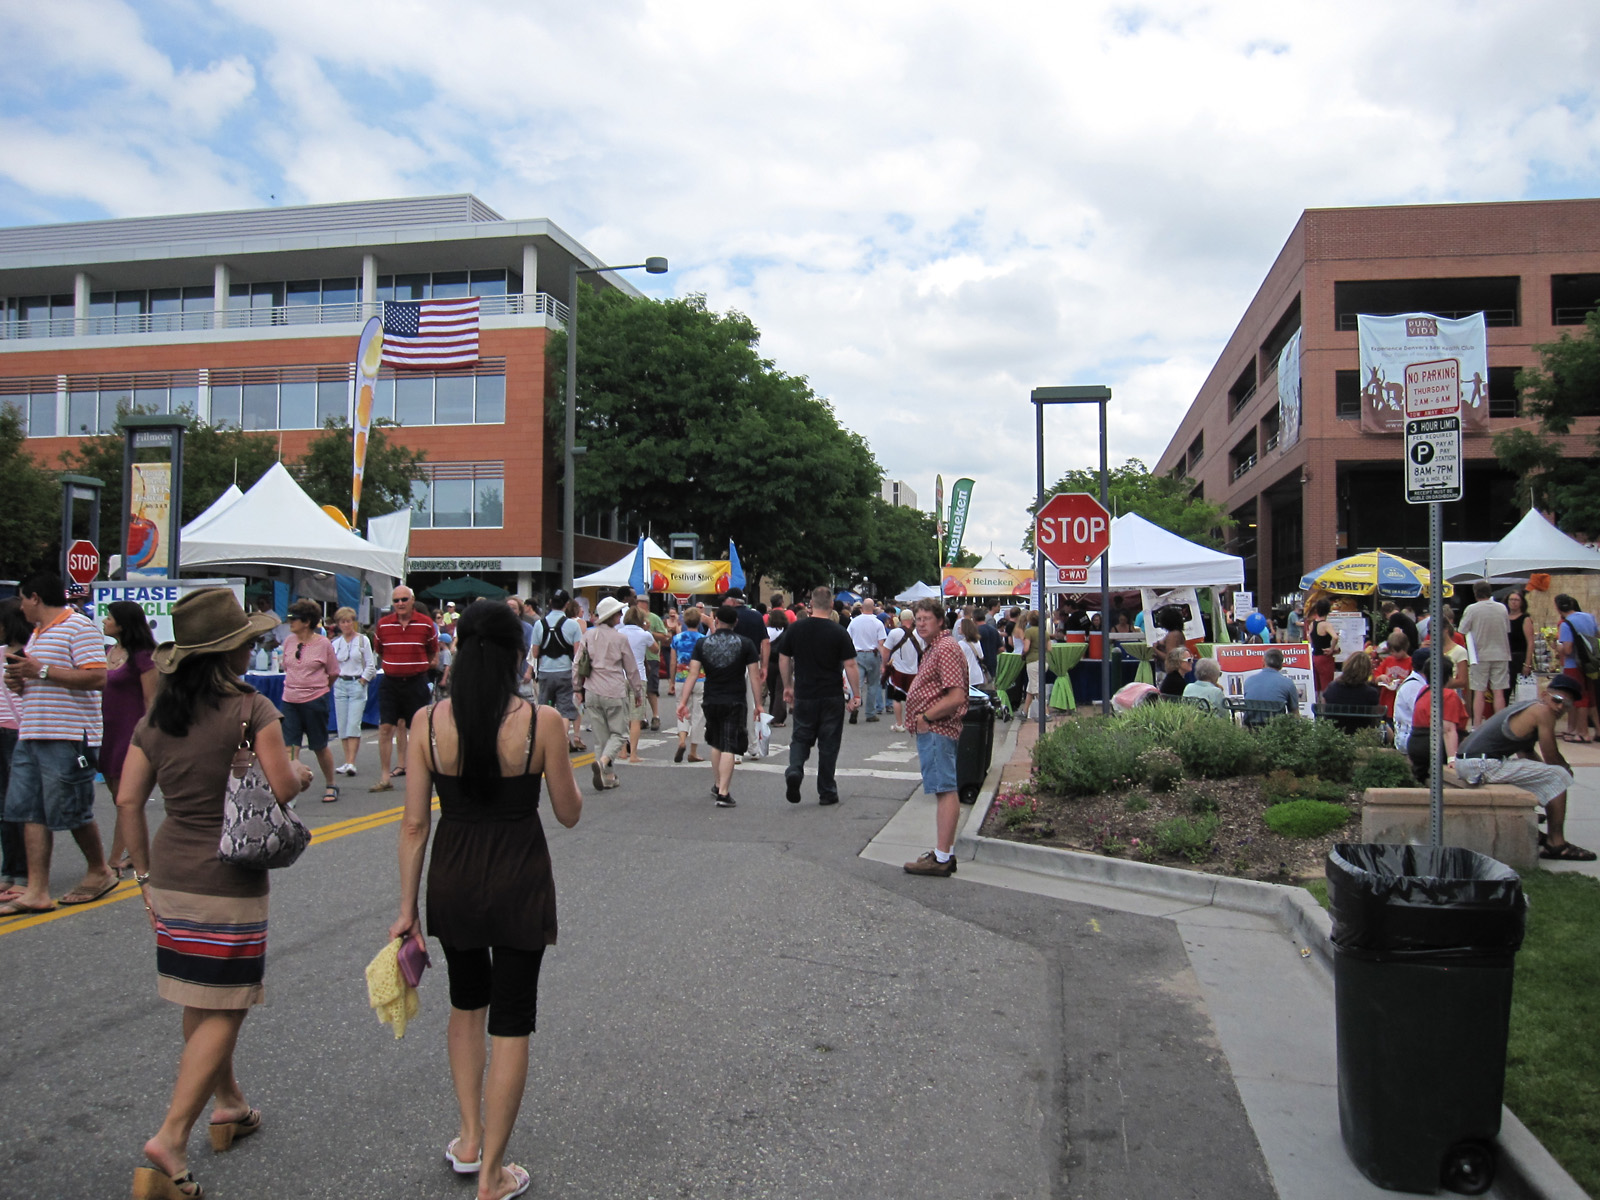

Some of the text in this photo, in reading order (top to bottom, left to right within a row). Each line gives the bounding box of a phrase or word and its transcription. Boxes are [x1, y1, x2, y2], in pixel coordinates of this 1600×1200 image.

[1409, 327, 1435, 335] VIDA
[1407, 367, 1456, 384] NO PARKING
[1413, 385, 1450, 395] THURSDAY
[1410, 422, 1418, 434] 3
[1420, 420, 1439, 431] HOUR
[1440, 419, 1456, 429] LIMIT
[948, 490, 967, 557] Heineken
[1041, 516, 1105, 544] STOP
[70, 554, 97, 571] STOP
[670, 573, 696, 581] Festival
[1060, 570, 1086, 579] 3-WAY
[973, 577, 1013, 586] Heineken
[1320, 580, 1374, 591] SABRETT
[98, 587, 177, 601] PLEASE
[98, 602, 175, 616] RCLE
[1221, 649, 1244, 657] Artist
